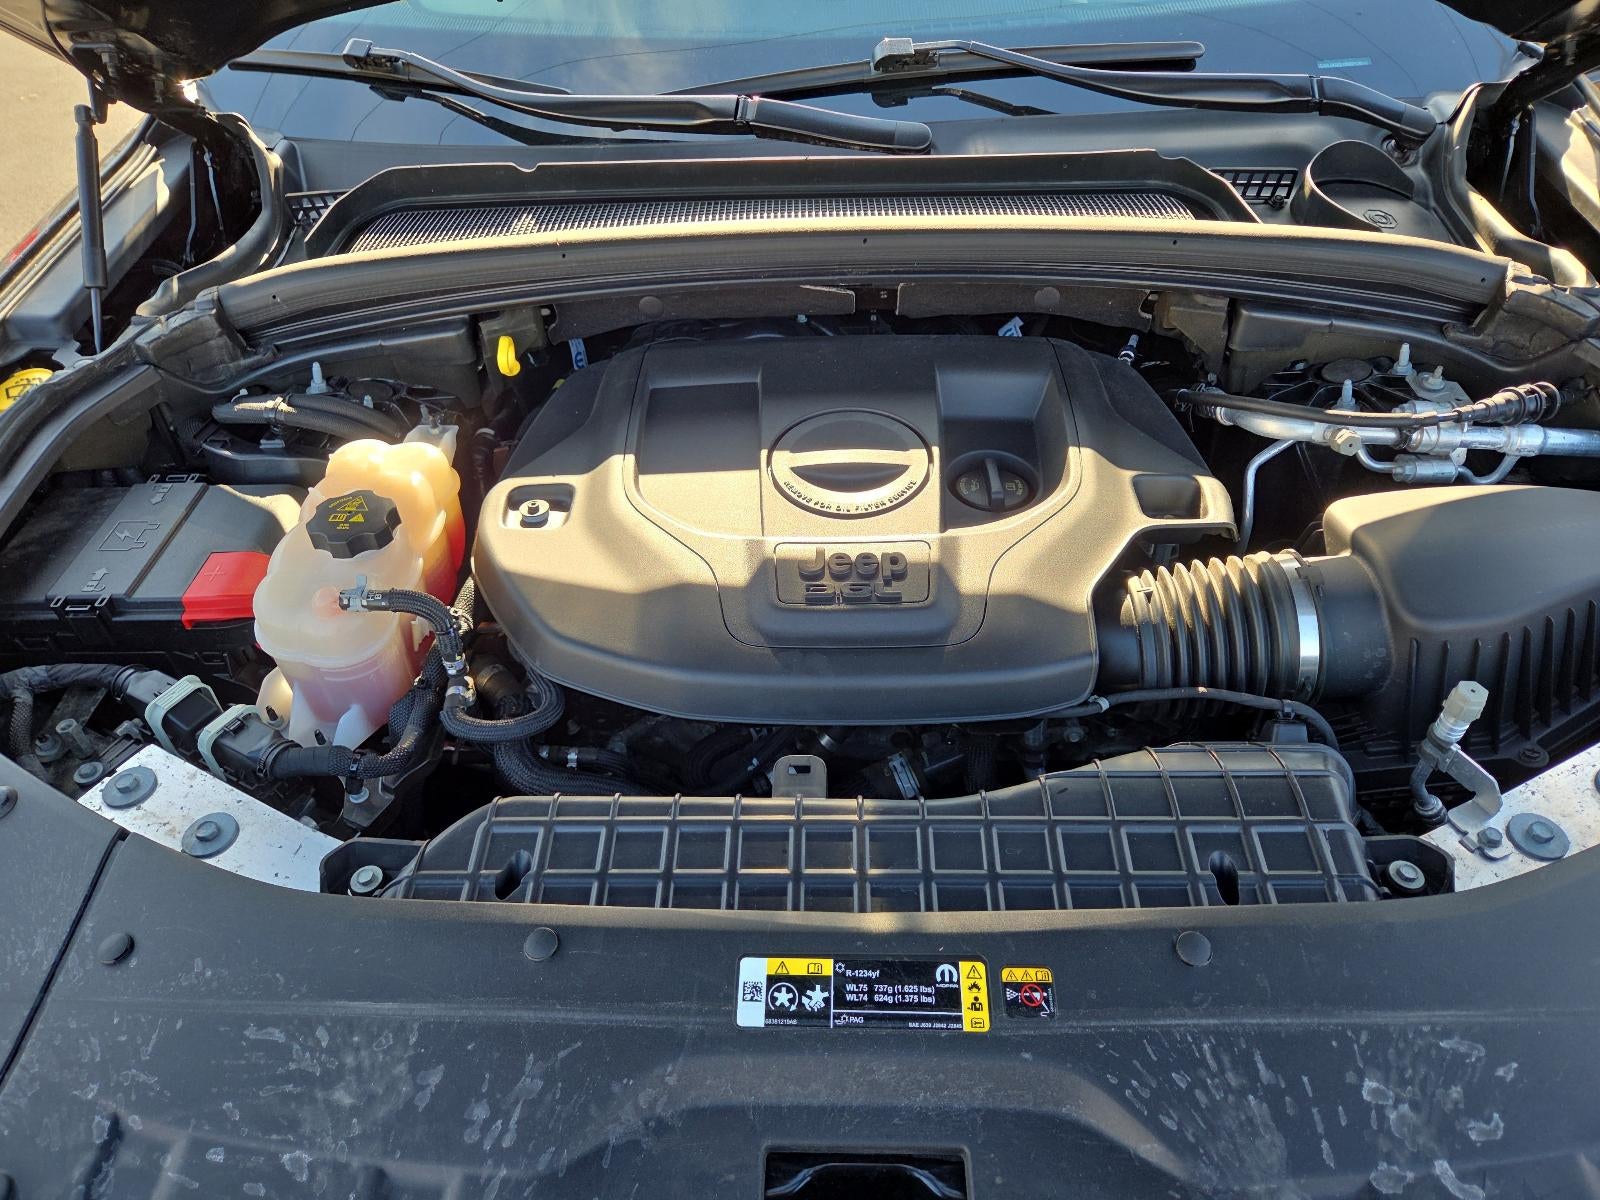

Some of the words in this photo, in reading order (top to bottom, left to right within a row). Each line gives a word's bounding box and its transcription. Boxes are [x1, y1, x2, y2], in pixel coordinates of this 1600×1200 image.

[813, 500, 832, 511] FOR
[798, 546, 908, 585] Jeep
[845, 969, 880, 979] R-1234yf
[845, 983, 868, 992] WL75
[873, 984, 894, 993] 737g
[894, 984, 919, 994] (1.625
[919, 984, 936, 995] lbs)
[845, 993, 869, 1002] WL74
[873, 994, 894, 1004] 624g
[894, 994, 919, 1004] (1.375
[920, 994, 936, 1005] lbs)
[849, 1016, 864, 1024] PAG
